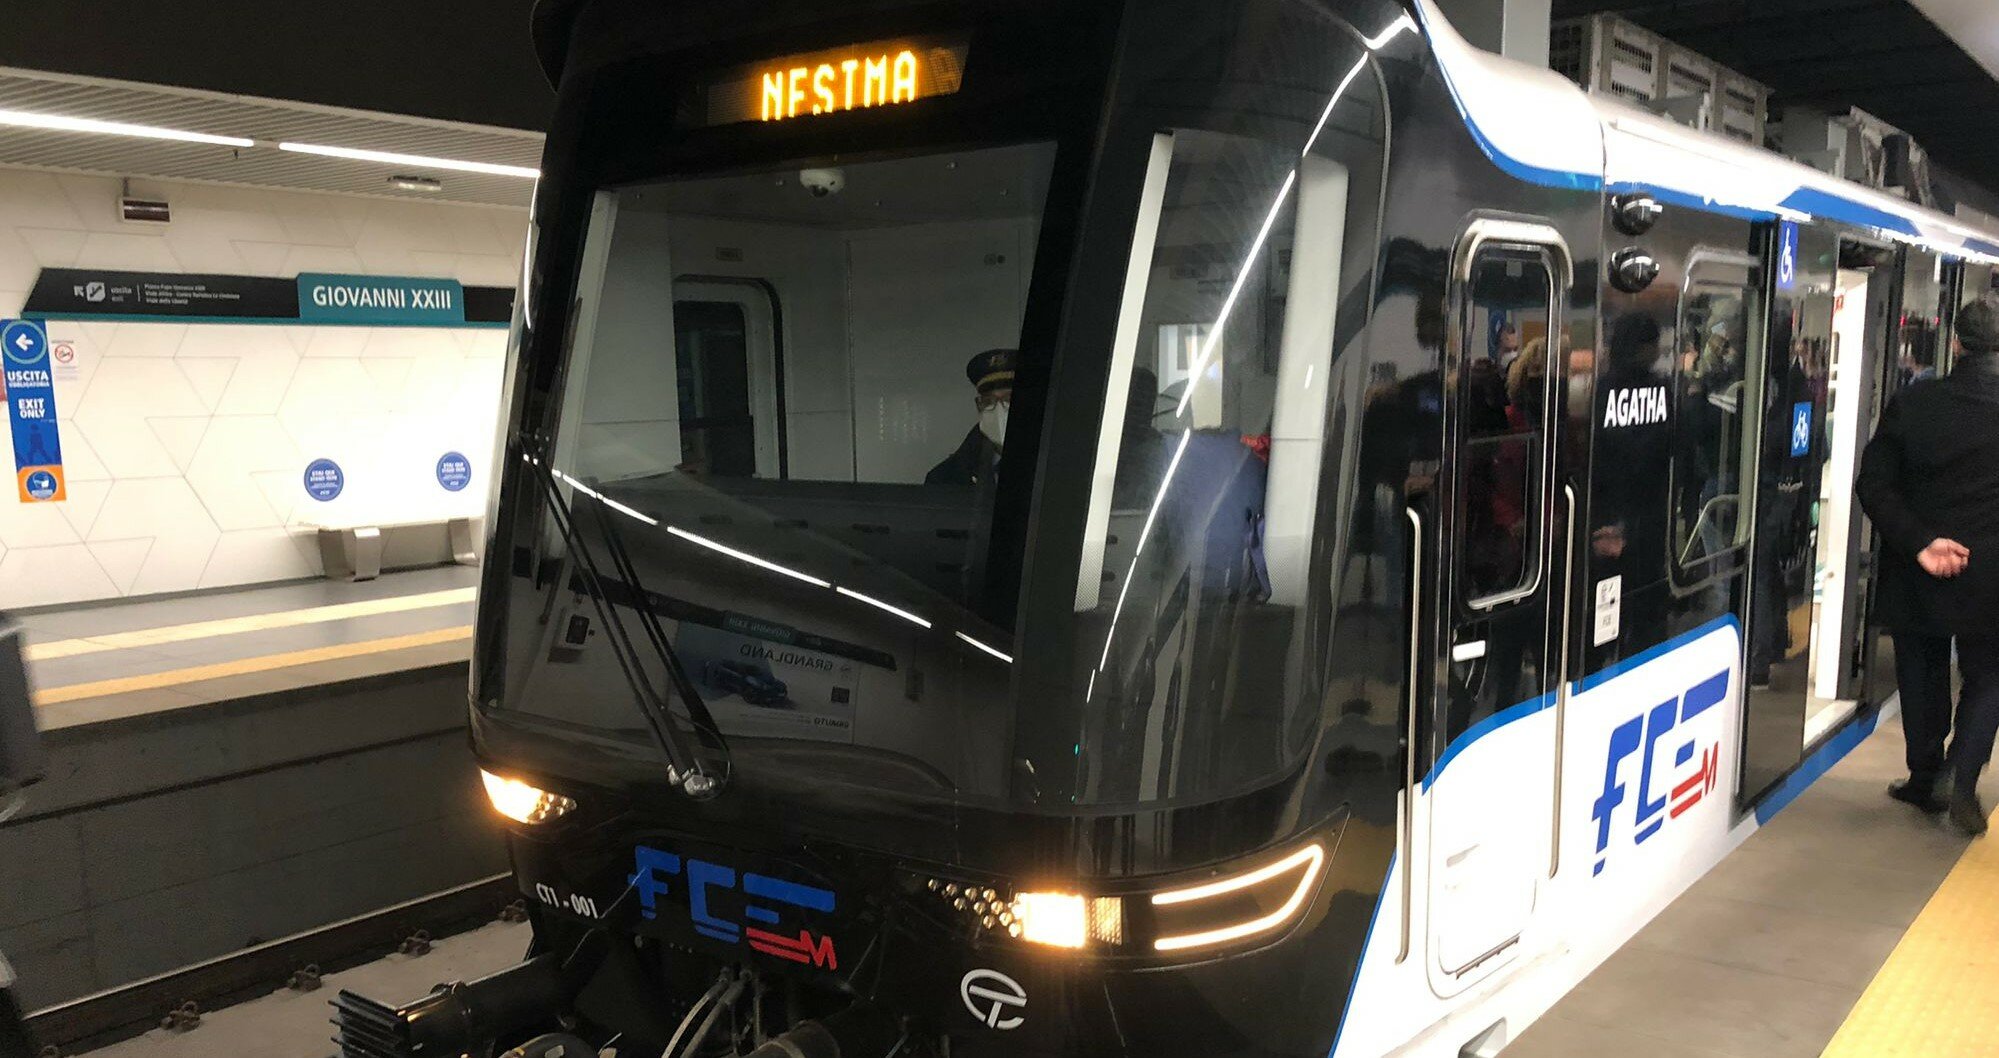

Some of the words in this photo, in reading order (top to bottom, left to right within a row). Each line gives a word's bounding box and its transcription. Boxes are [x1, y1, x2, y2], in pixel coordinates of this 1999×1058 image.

[312, 285, 406, 308] GIOVANNI
[411, 288, 451, 310] XXIII
[7, 370, 49, 382] USCITA
[18, 397, 44, 410] EXIT
[1603, 386, 1667, 428] AGATHA
[20, 409, 45, 419] ONLY
[570, 893, 599, 919] 001
